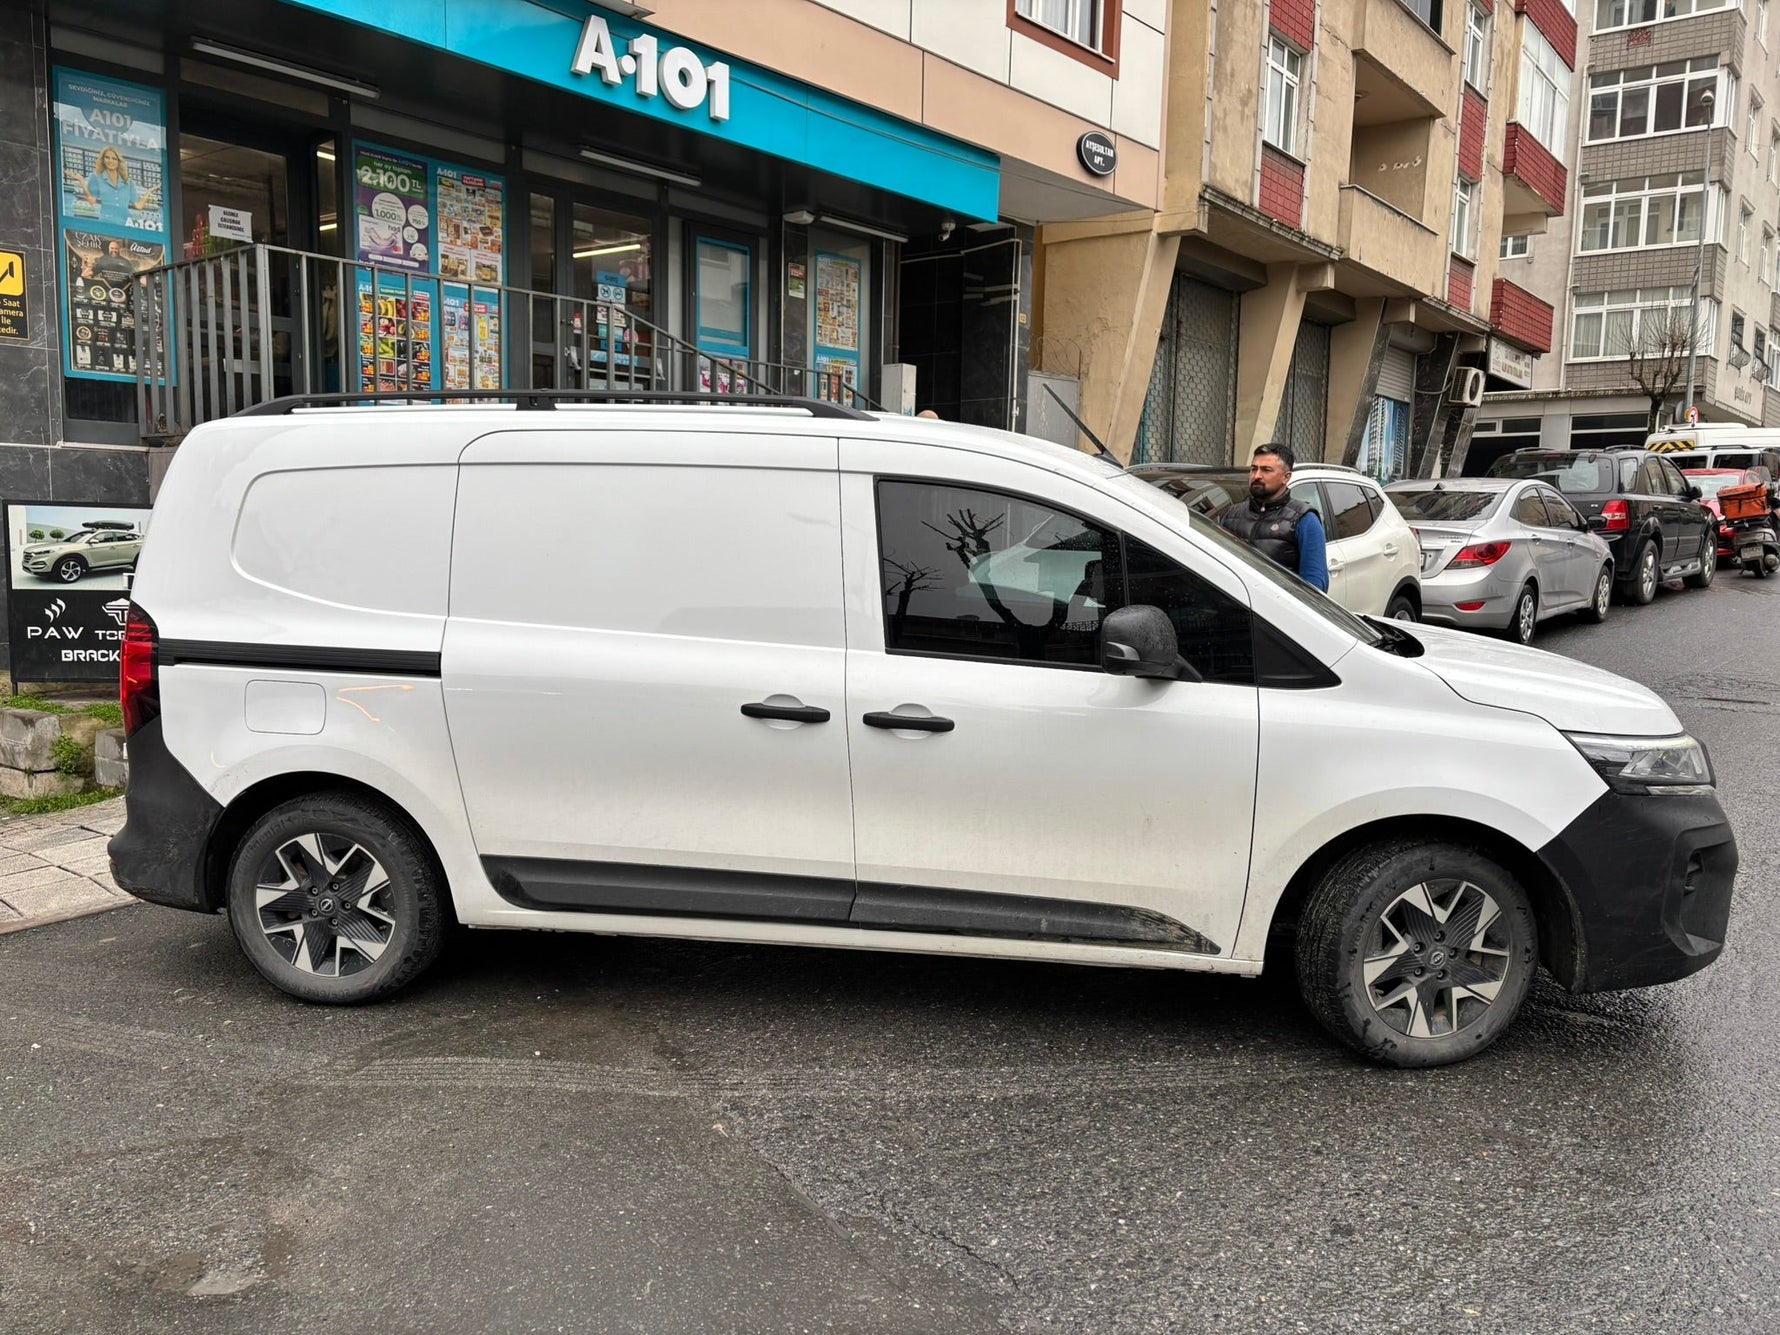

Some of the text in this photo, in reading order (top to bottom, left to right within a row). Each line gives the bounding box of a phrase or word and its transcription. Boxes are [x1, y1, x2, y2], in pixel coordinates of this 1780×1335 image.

[411, 179, 422, 189] TL
[3, 298, 21, 308] Saat
[27, 626, 84, 640] PAW
